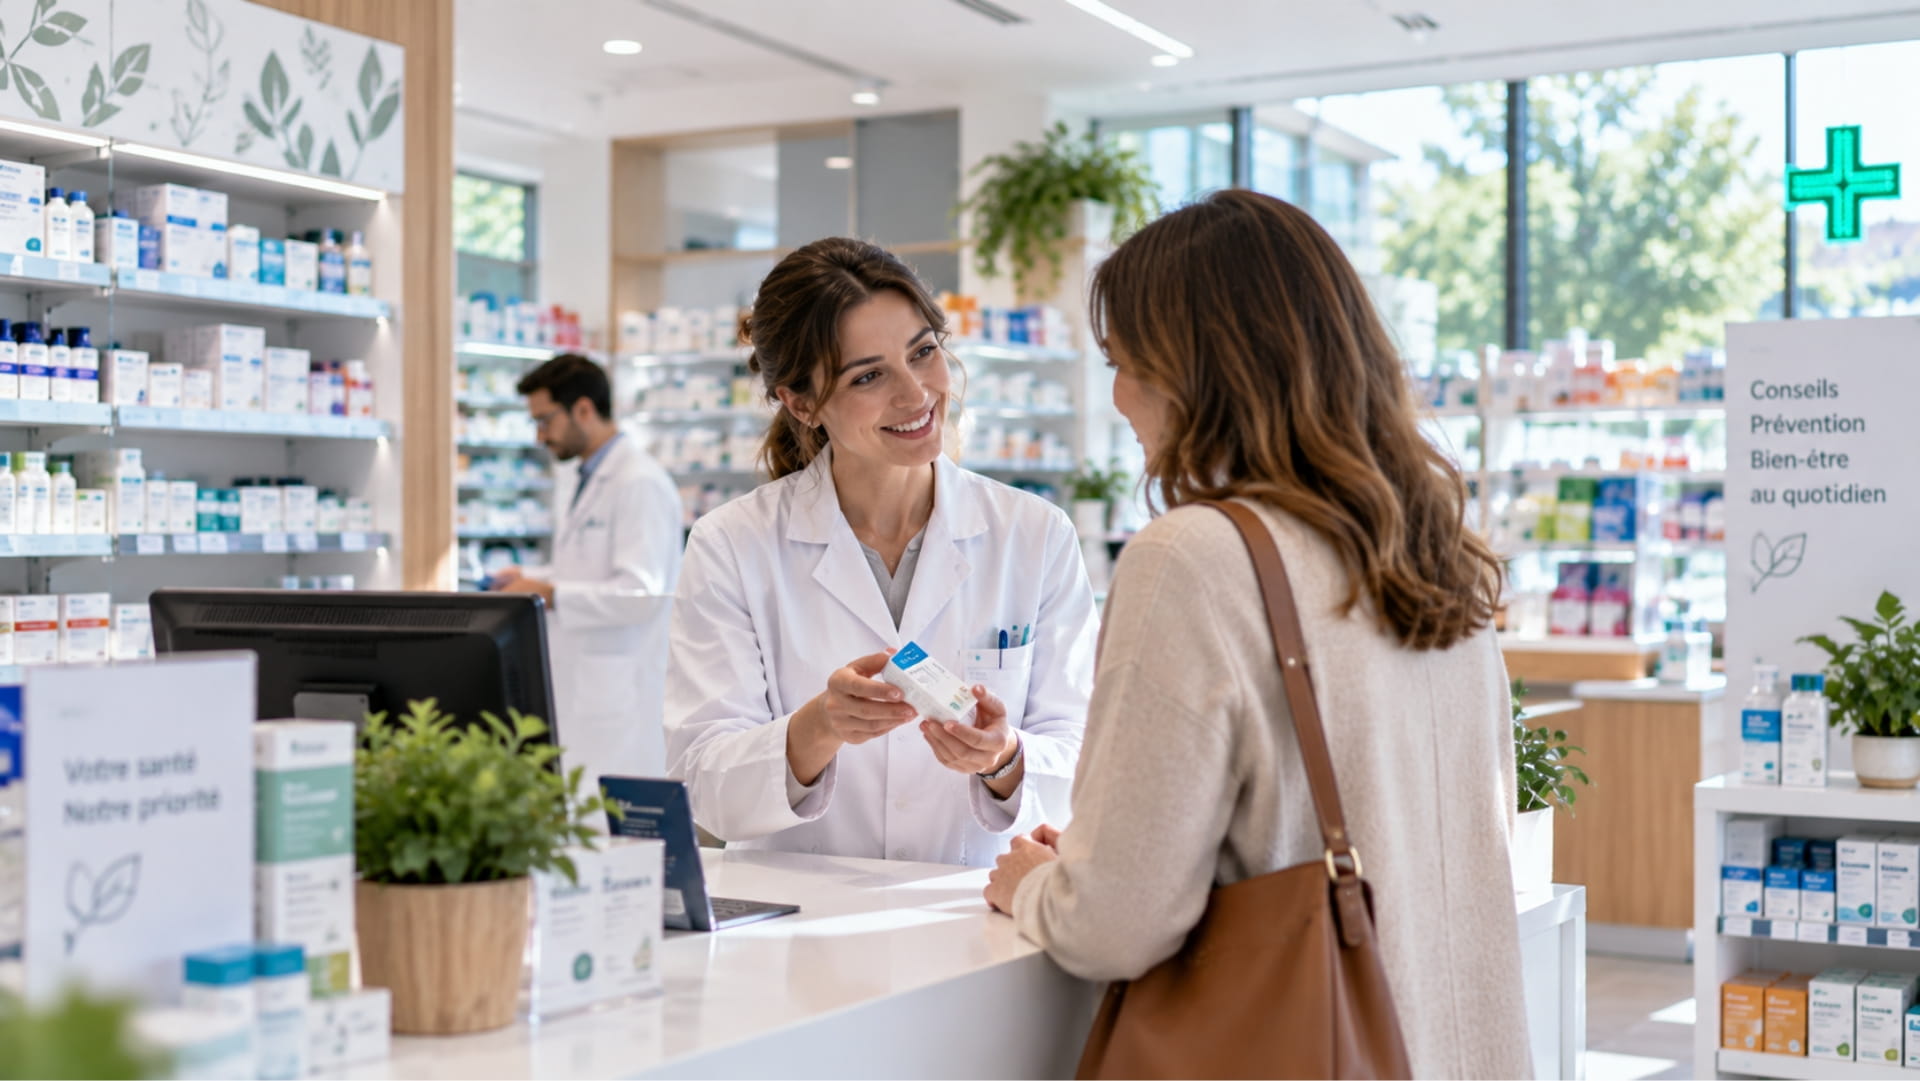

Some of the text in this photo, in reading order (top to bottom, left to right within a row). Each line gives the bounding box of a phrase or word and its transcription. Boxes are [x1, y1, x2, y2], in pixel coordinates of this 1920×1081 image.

[1750, 378, 1839, 400] Conseils
[1750, 413, 1866, 434] Prévention
[1750, 483, 1887, 508] au quotidien
[63, 748, 197, 785] Votre santé
[63, 786, 219, 824] Notre priorité
